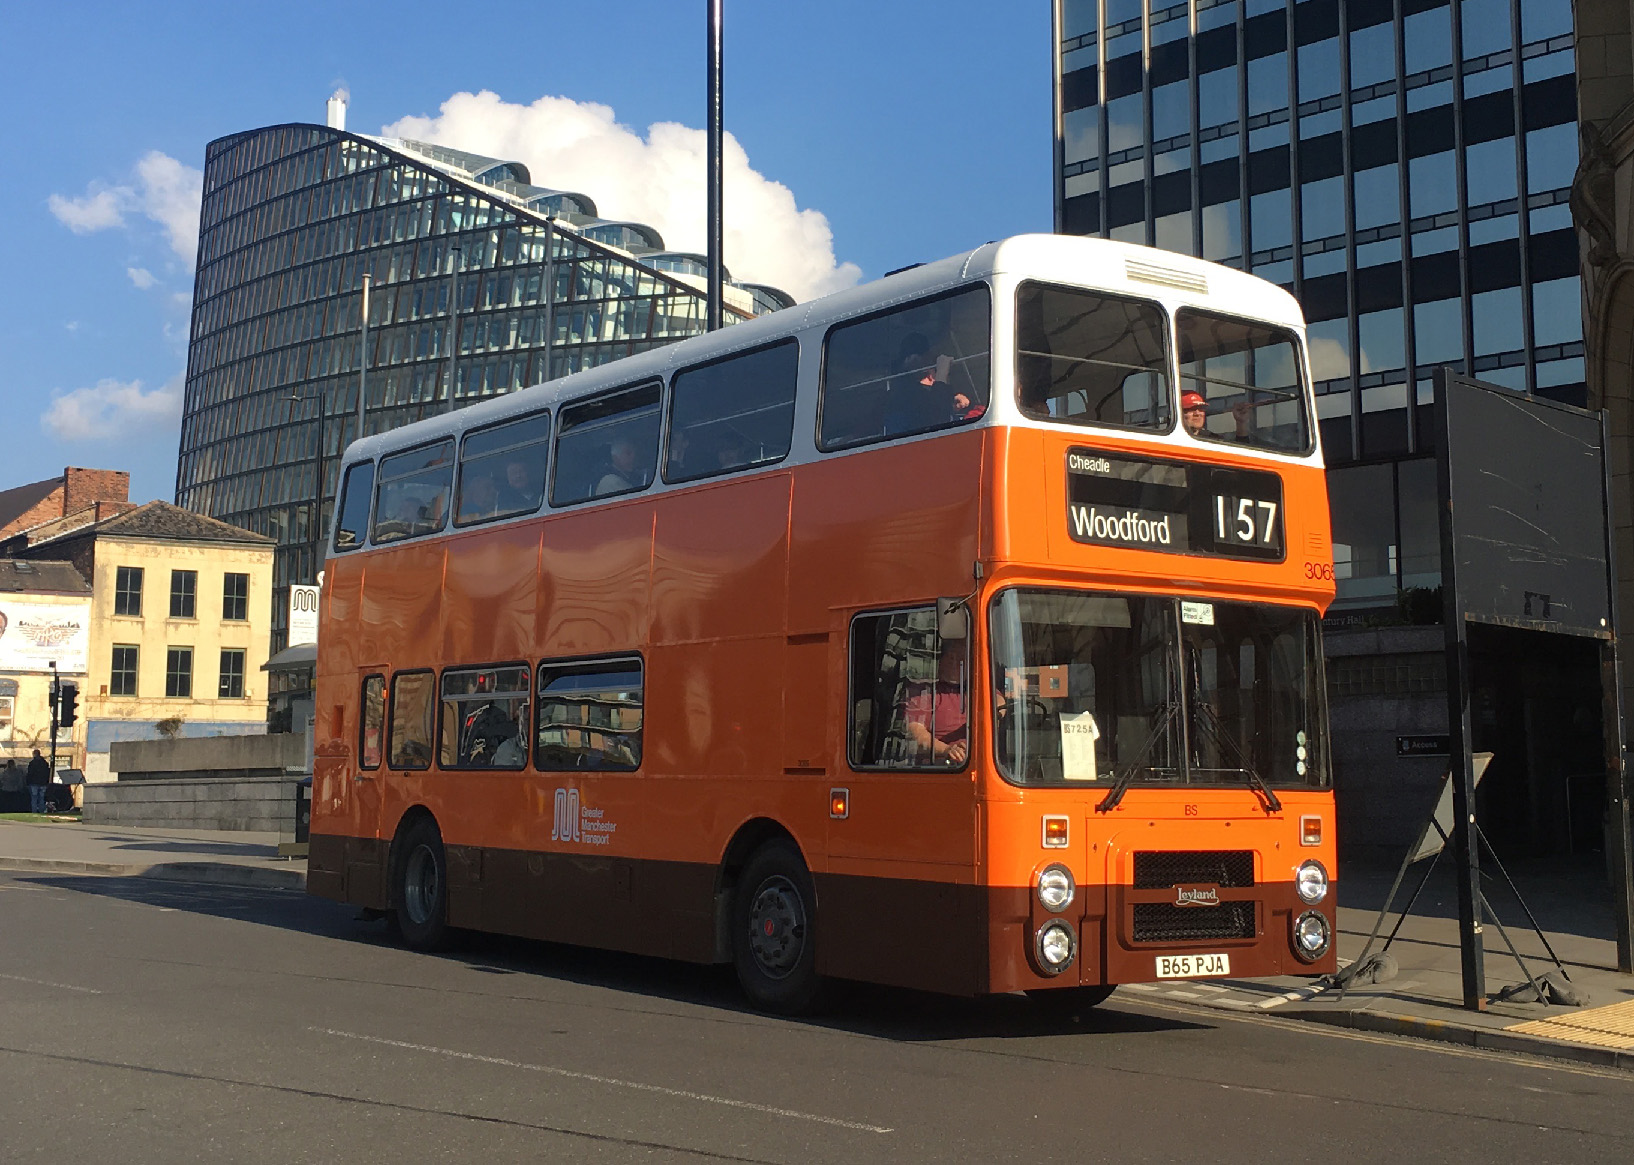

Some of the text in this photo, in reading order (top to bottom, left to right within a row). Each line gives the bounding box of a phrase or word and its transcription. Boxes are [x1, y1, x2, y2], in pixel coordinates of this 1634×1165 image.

[1069, 454, 1110, 473] Cheadle
[1071, 505, 1171, 544] Woodford
[1216, 495, 1277, 543] 157
[581, 806, 605, 818] Greater
[1184, 805, 1198, 816] BS
[581, 819, 617, 833] Manchester
[581, 831, 610, 847] Transport
[1176, 887, 1218, 903] Leyland
[1162, 955, 1225, 975] B65 PJA
